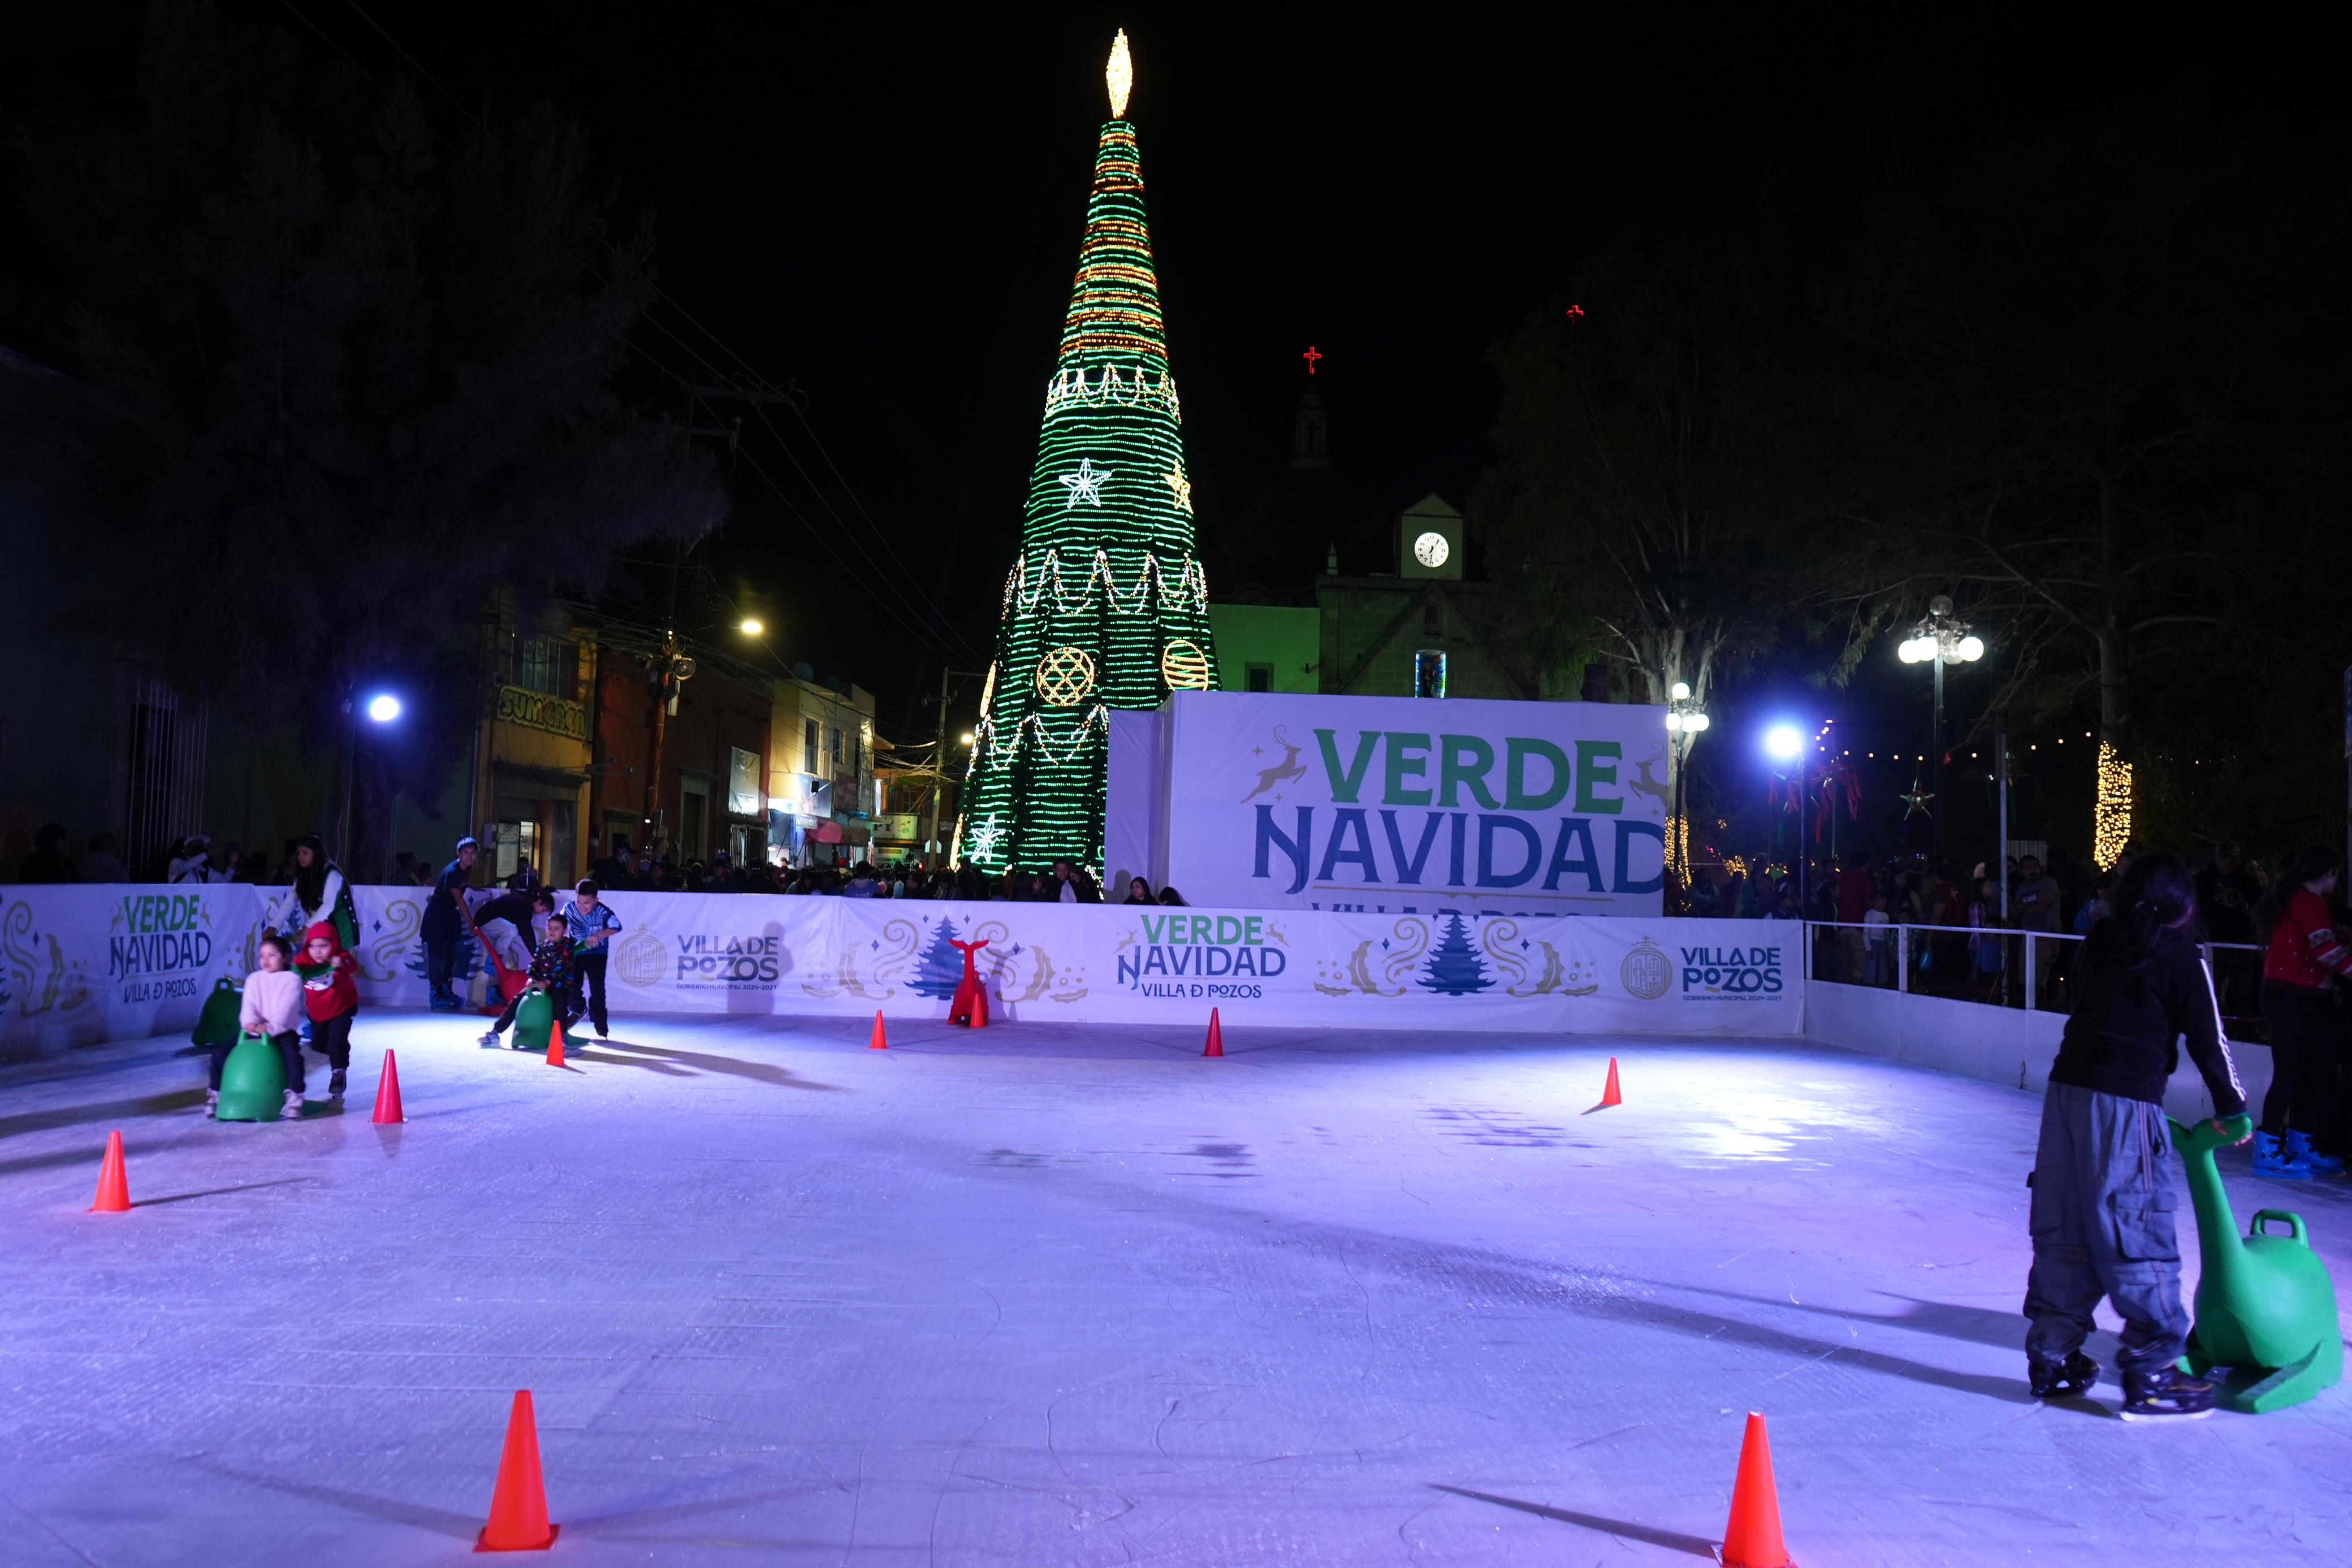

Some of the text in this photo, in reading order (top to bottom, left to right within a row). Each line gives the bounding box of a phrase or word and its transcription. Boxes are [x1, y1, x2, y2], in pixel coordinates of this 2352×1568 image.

[1313, 729, 1624, 814] VERDE
[1251, 804, 1664, 895] NAVIDAD
[124, 894, 200, 933] VERDE
[677, 934, 779, 955] VILLA DE
[1140, 914, 1264, 946] VERDE
[108, 932, 211, 984] NAVIDAD
[677, 955, 779, 982] POZOS
[1117, 945, 1286, 990] NAVIDAD
[1680, 947, 1781, 967] VILLA DE
[124, 983, 150, 1003] VILLA
[165, 977, 196, 998] POZOS
[1141, 983, 1186, 998] VILLA
[1208, 984, 1262, 998] POZOS
[1682, 967, 1783, 993] POZOS
